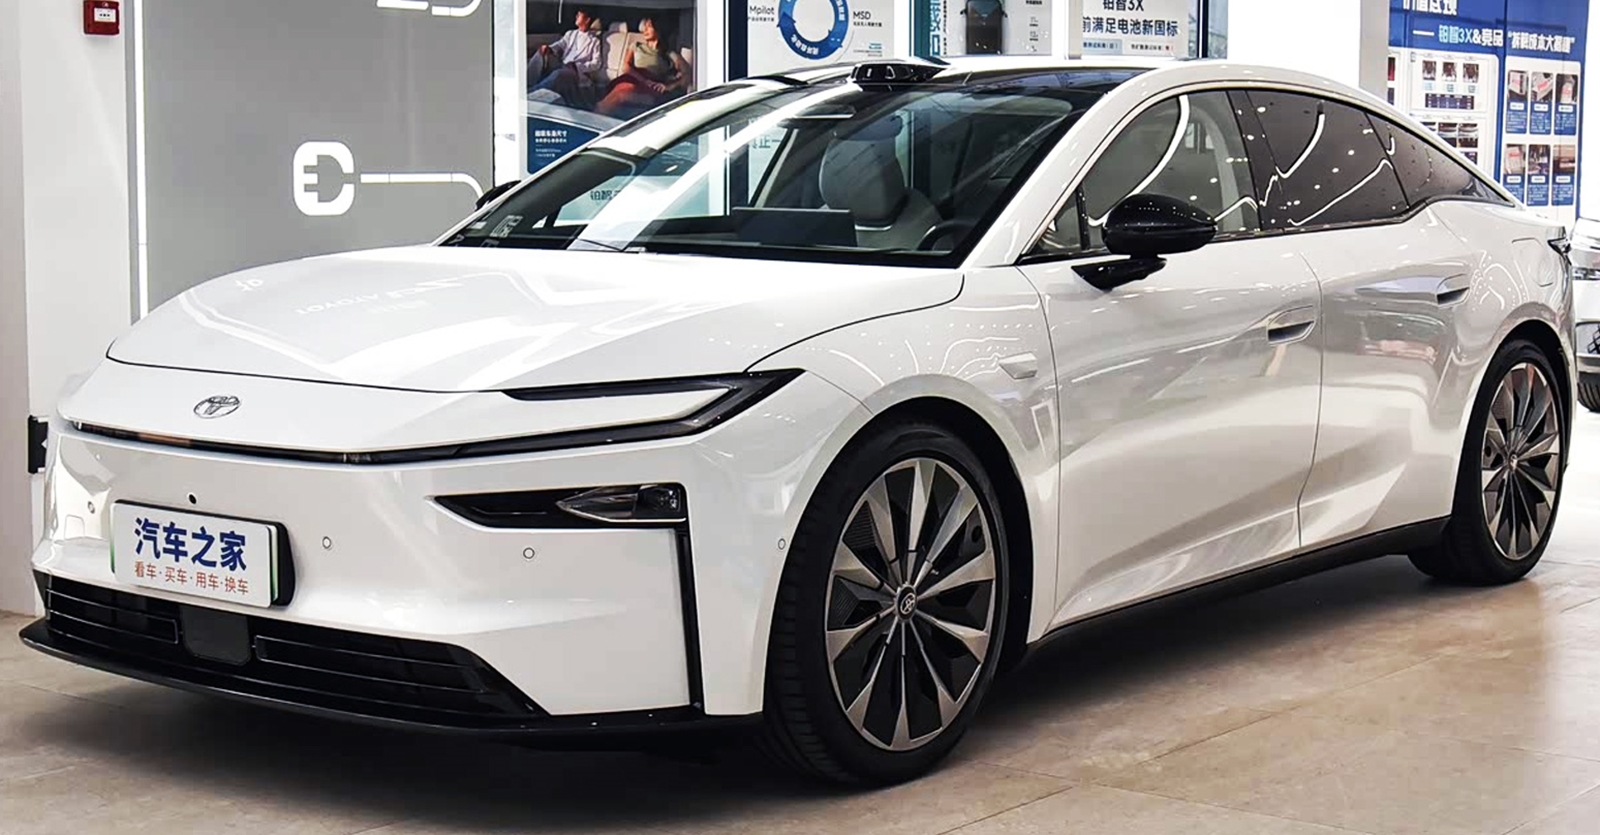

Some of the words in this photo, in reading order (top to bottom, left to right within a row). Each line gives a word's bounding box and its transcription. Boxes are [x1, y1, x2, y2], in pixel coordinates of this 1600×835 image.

[749, 6, 775, 18] Mpilot
[852, 11, 871, 20] MSD
[134, 517, 247, 572] 汽车之家
[134, 560, 250, 596] 看车·买车·用车·换车
